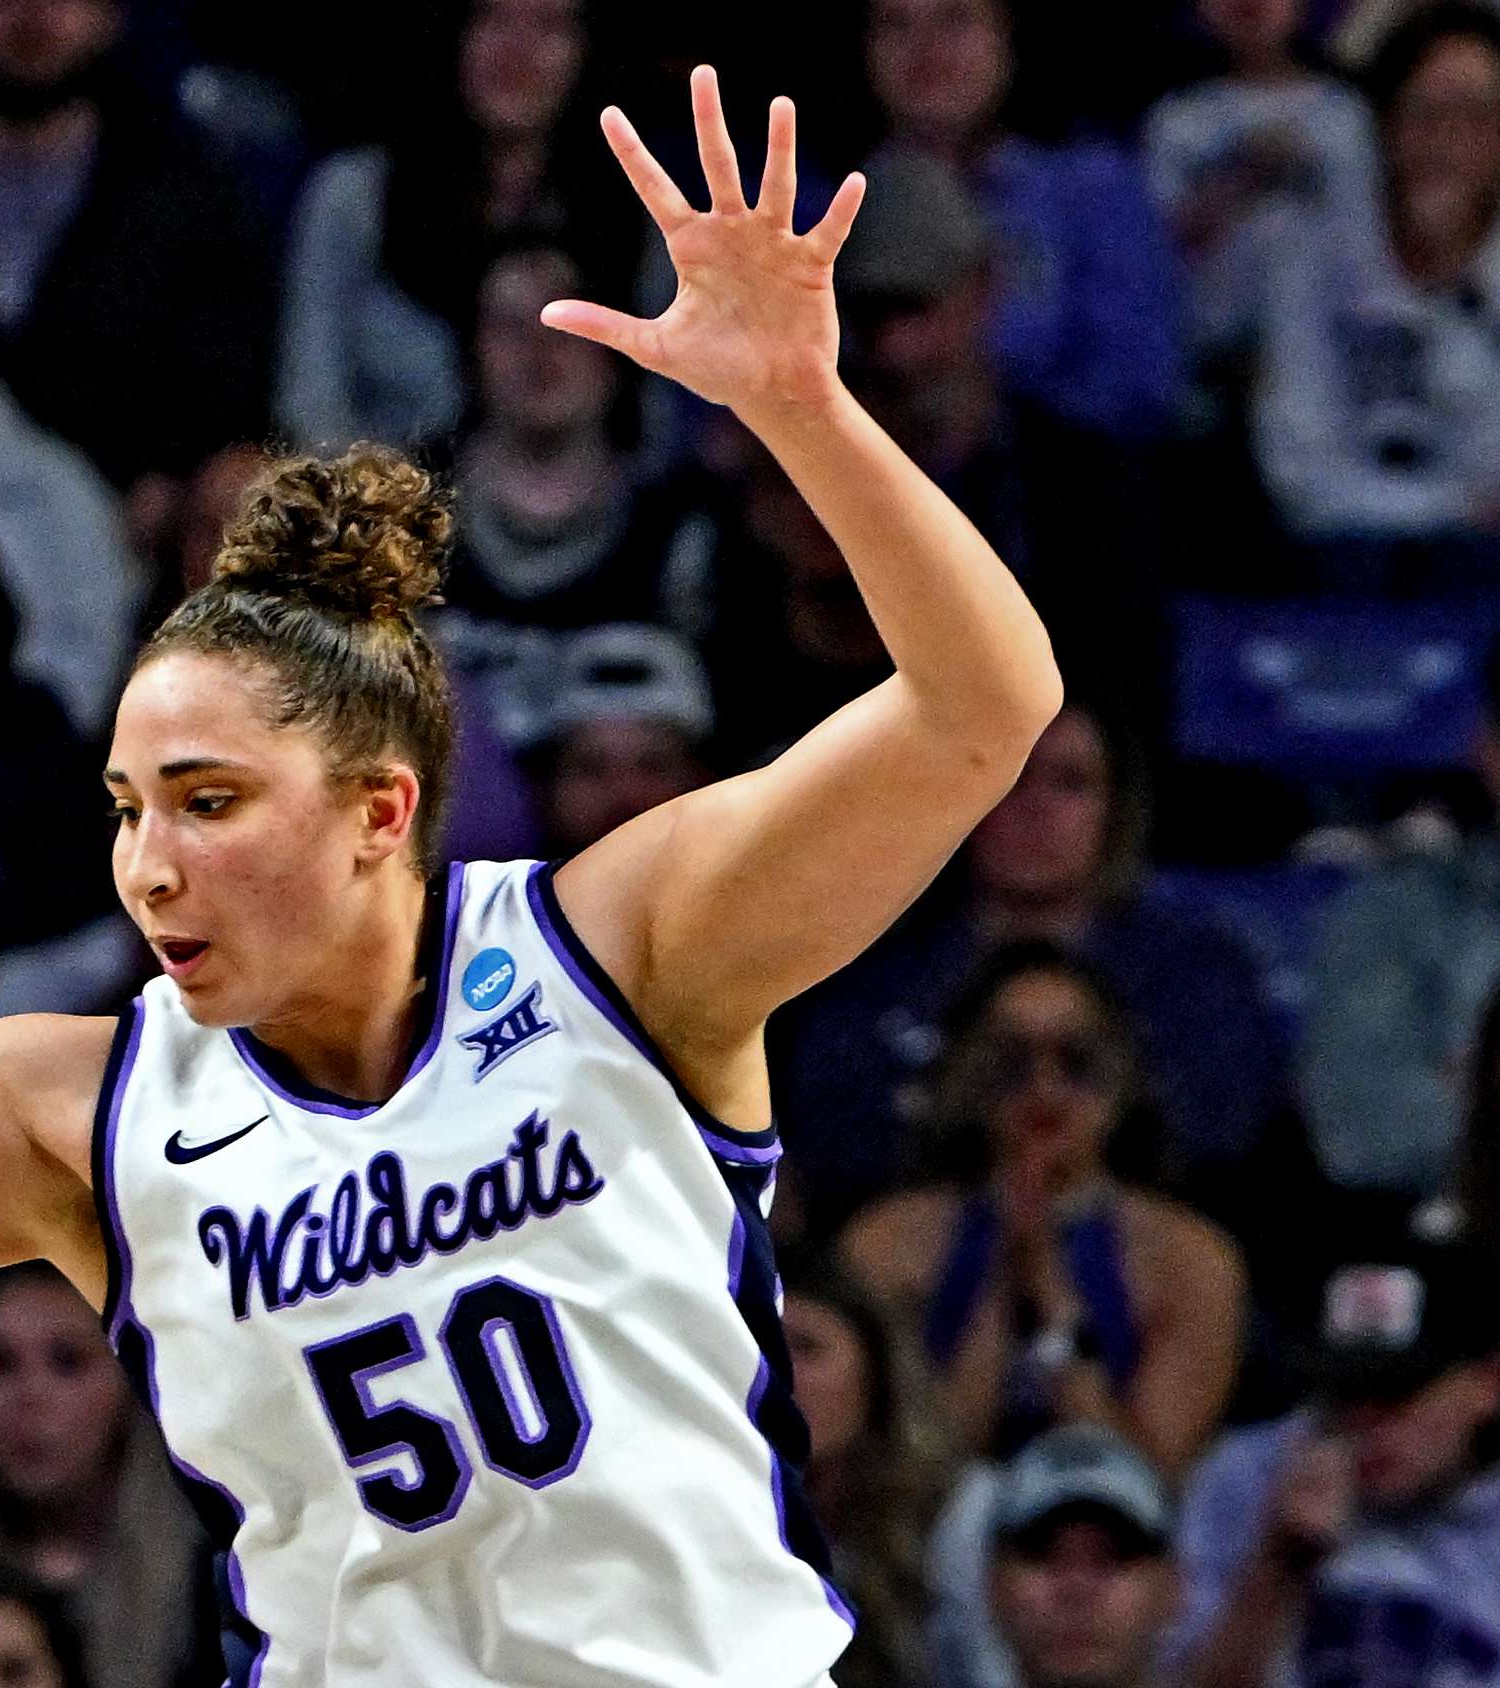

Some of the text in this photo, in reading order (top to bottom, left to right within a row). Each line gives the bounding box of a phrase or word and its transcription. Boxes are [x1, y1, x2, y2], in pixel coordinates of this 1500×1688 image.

[459, 985, 553, 1076] XII
[470, 962, 513, 1003] NCAA
[199, 1109, 604, 1321] Wildcats
[302, 1274, 592, 1533] 50
